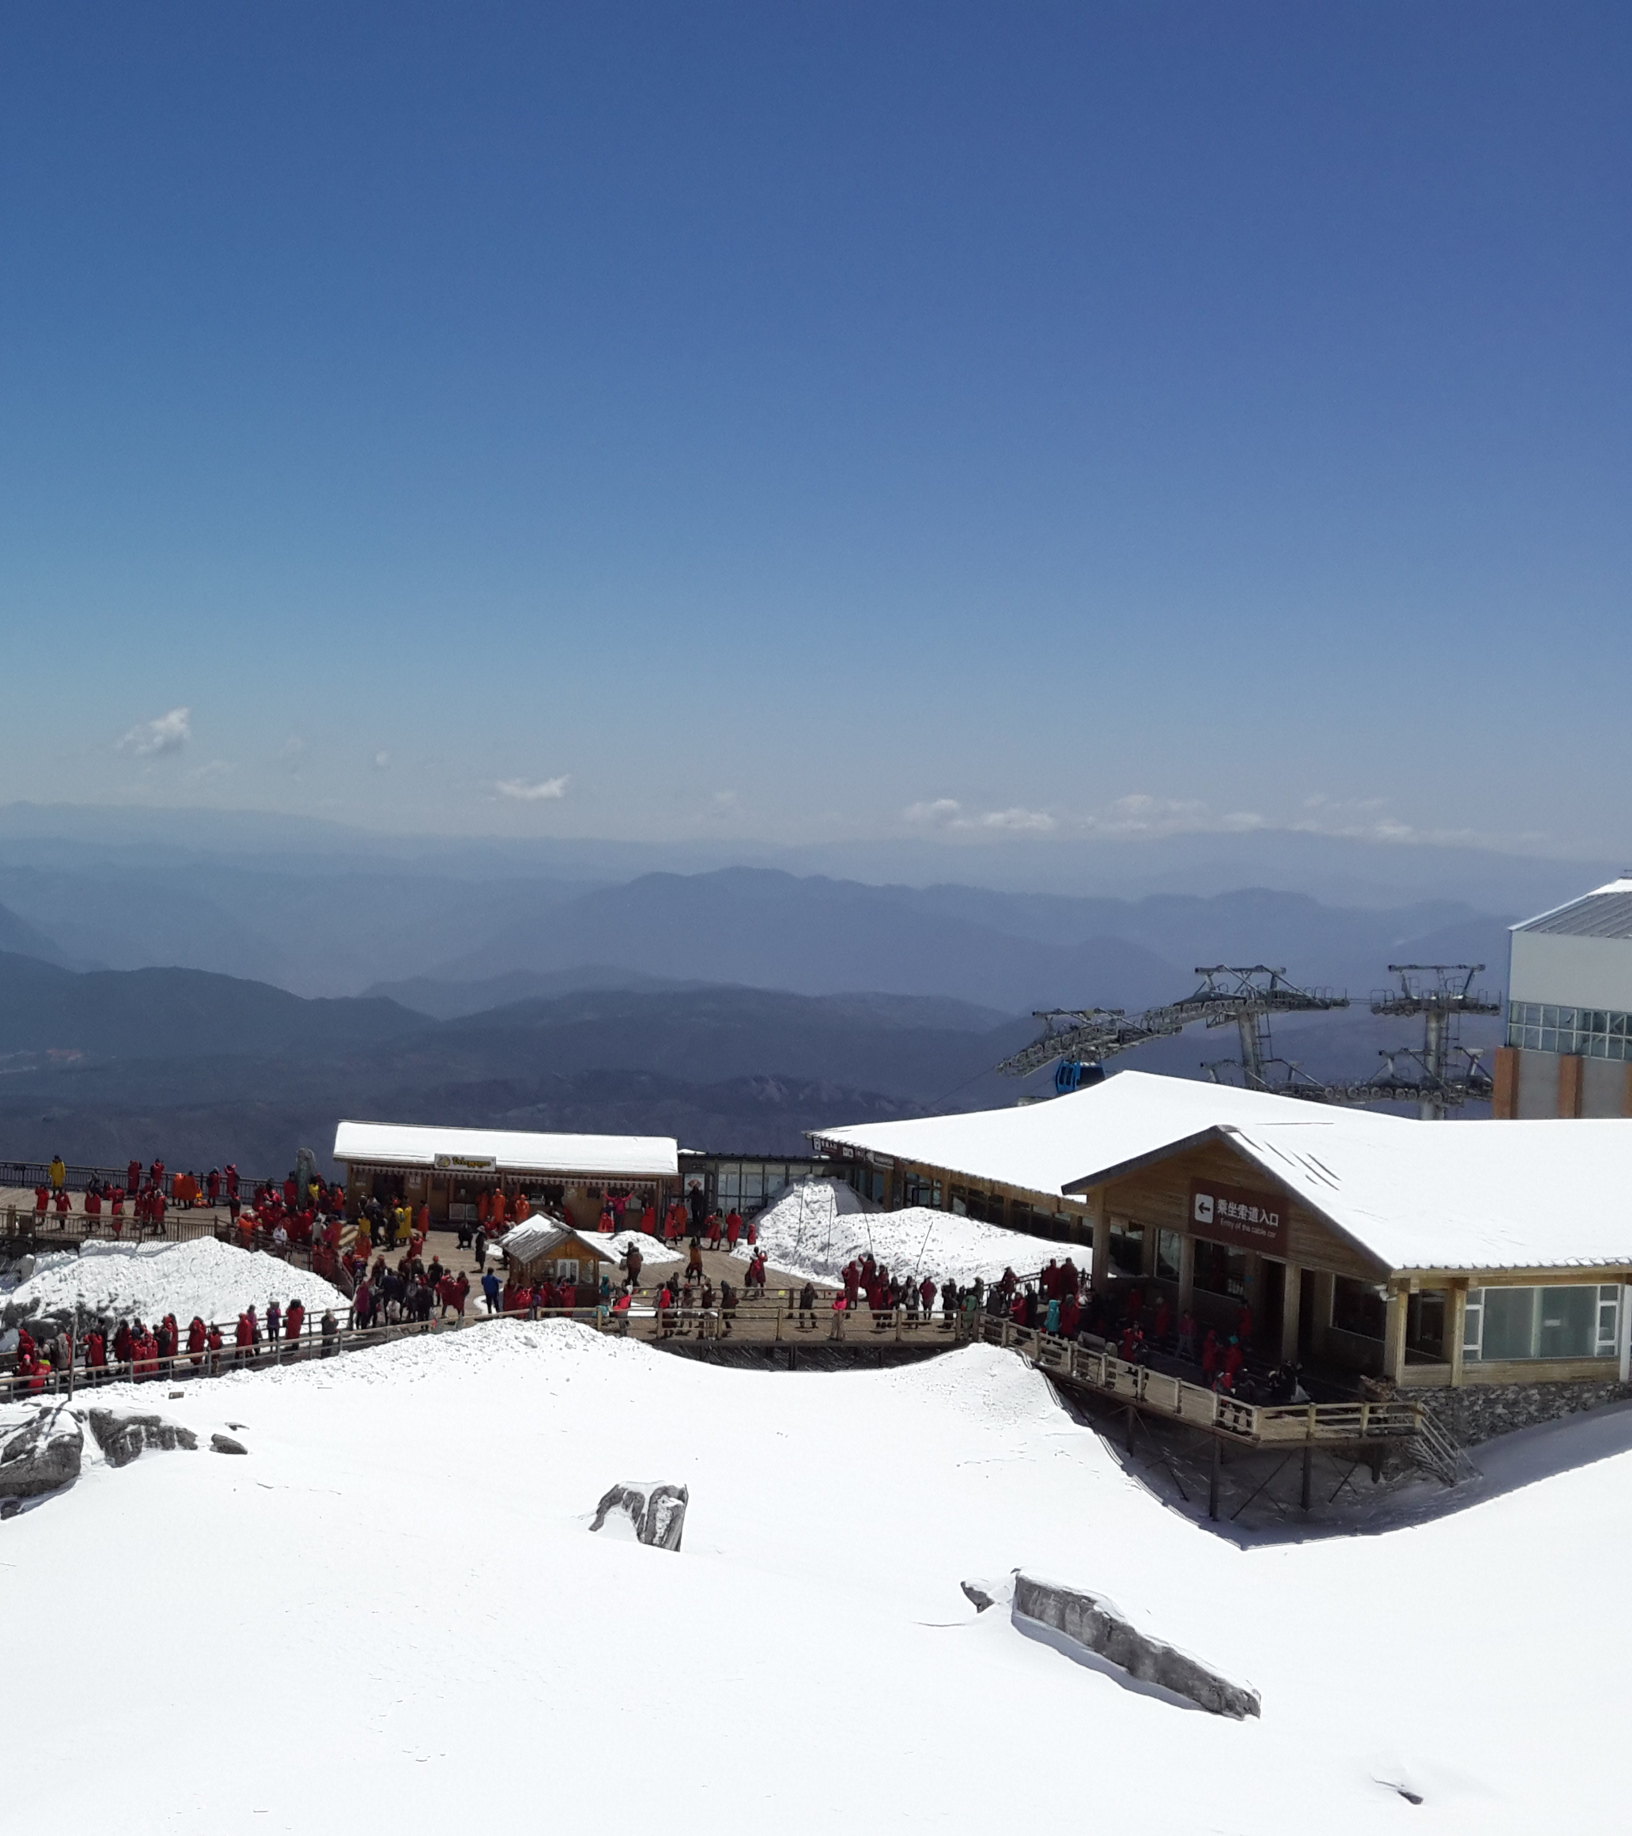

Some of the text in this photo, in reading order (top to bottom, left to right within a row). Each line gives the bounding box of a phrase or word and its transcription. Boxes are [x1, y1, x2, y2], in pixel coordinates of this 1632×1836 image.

[1217, 1199, 1279, 1227] 乘坐索道入口
